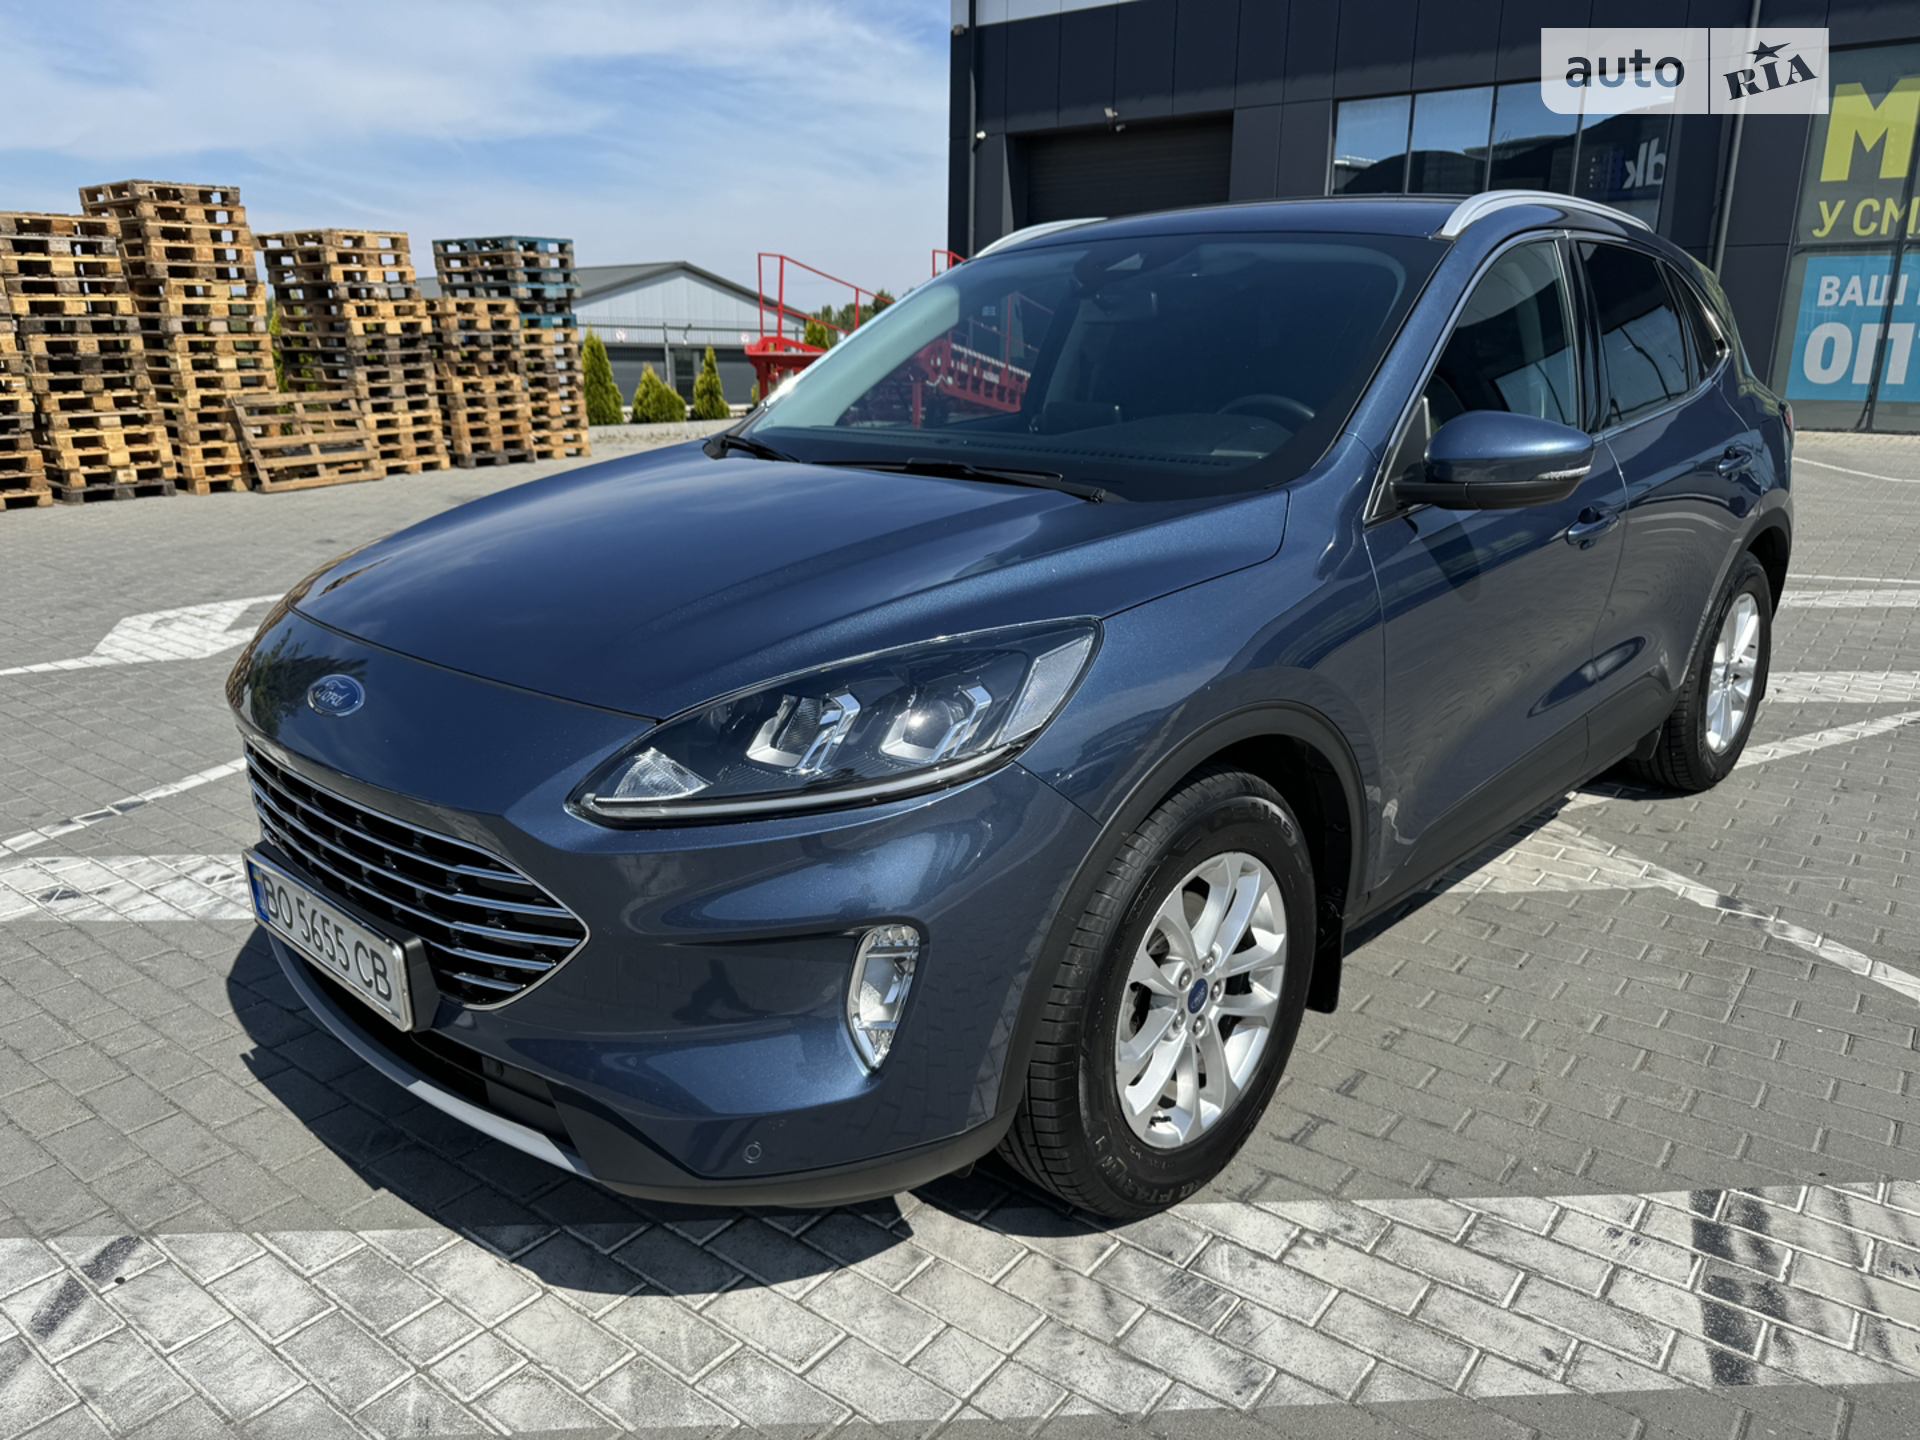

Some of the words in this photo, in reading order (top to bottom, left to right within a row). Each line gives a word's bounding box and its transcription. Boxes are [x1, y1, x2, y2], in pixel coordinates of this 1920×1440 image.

[1812, 199, 1846, 238] У
[1852, 196, 1920, 237] СМ
[1817, 274, 1909, 307] ВАШ
[1803, 322, 1920, 385] ОП
[315, 680, 350, 707] Ford
[261, 872, 294, 930] BO
[296, 896, 350, 972] 5655
[354, 940, 392, 1002] CB
